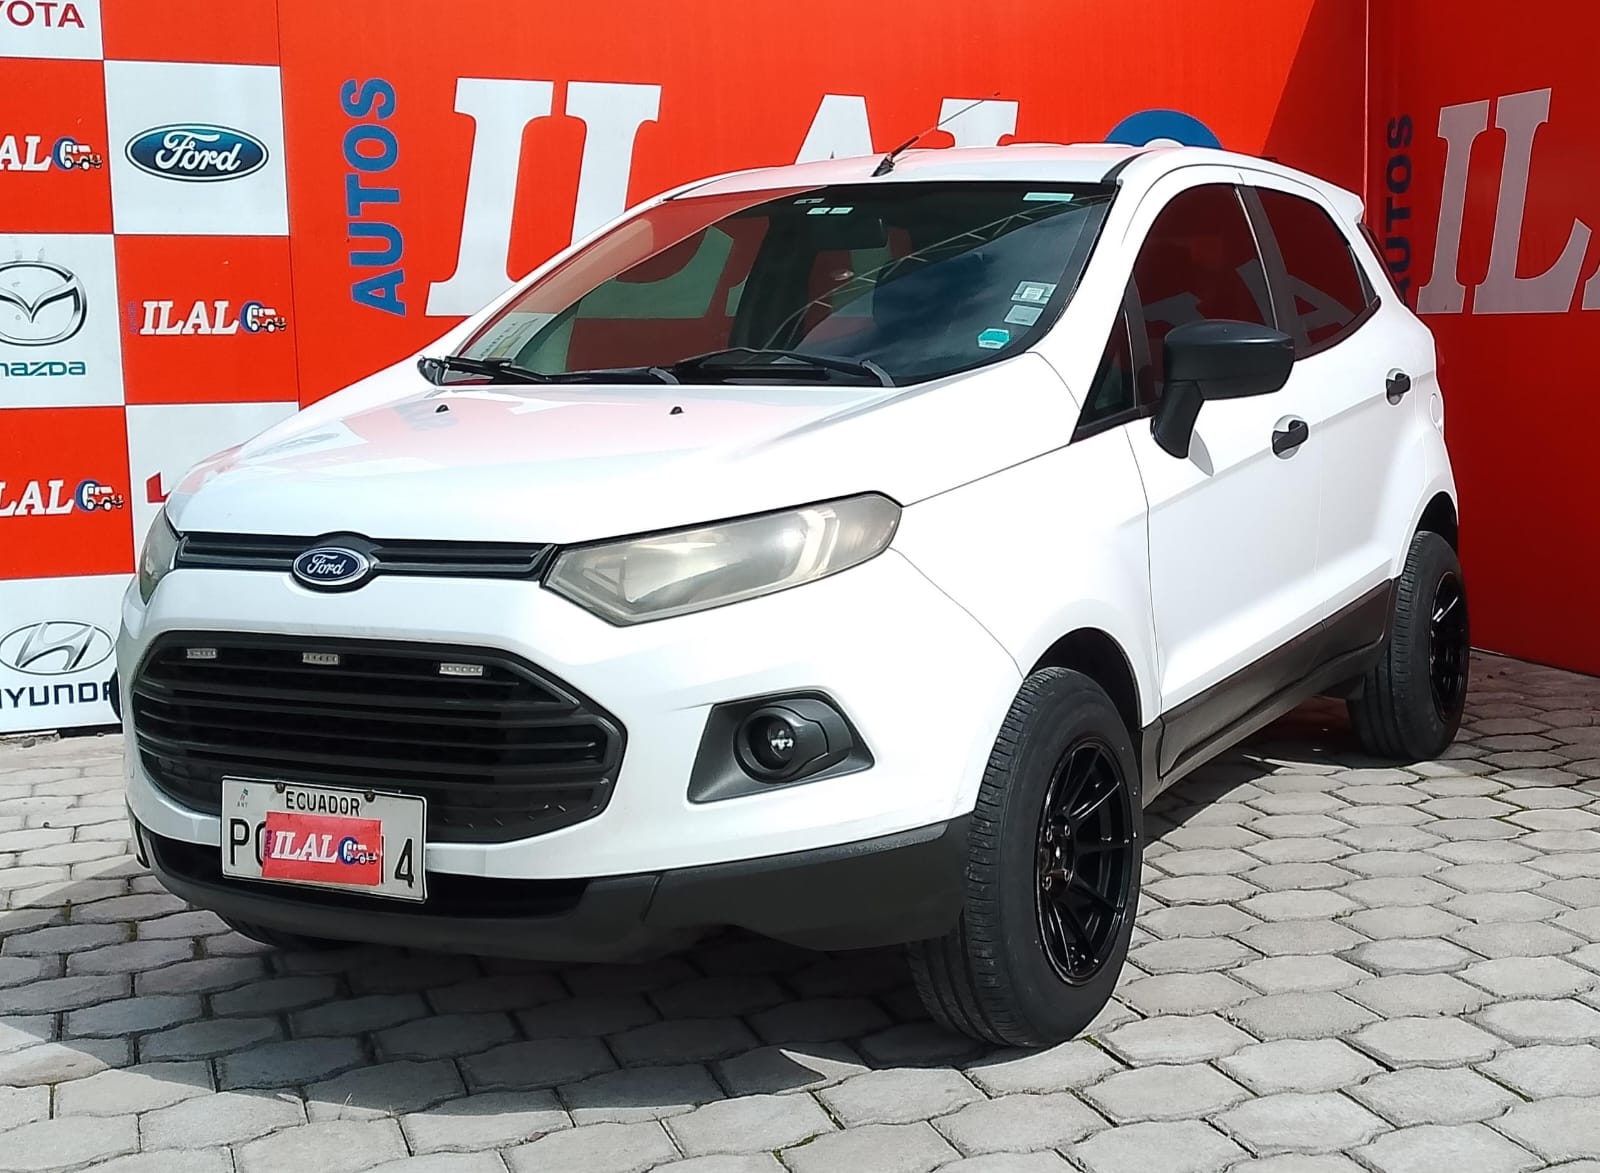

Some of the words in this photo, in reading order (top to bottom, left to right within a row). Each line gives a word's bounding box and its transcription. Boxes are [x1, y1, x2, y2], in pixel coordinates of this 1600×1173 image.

[155, 131, 242, 171] Ford
[340, 77, 406, 316] AUTOS
[306, 553, 347, 575] Ford
[285, 790, 361, 817] ECUADOR
